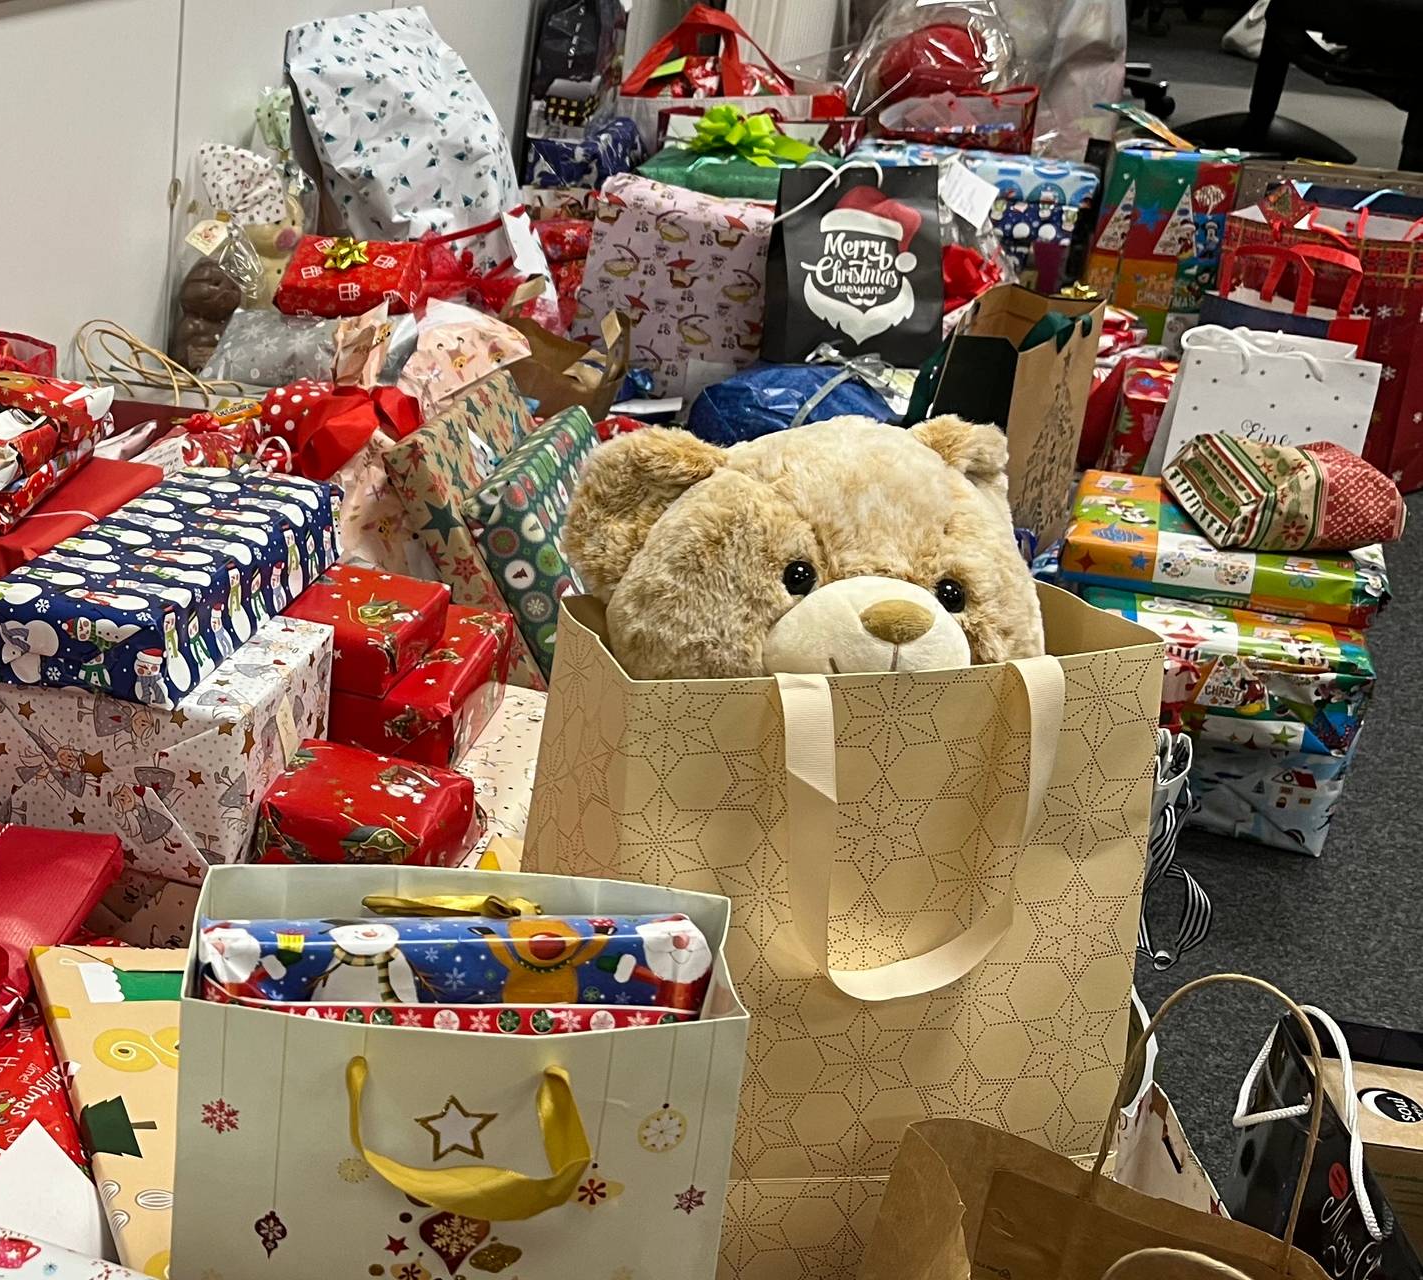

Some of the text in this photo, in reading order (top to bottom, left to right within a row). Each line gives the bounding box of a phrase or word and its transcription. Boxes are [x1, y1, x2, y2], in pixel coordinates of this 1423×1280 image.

[823, 232, 893, 271] Merry
[801, 257, 898, 288] Christmas
[9, 1065, 64, 1118] hristmas
